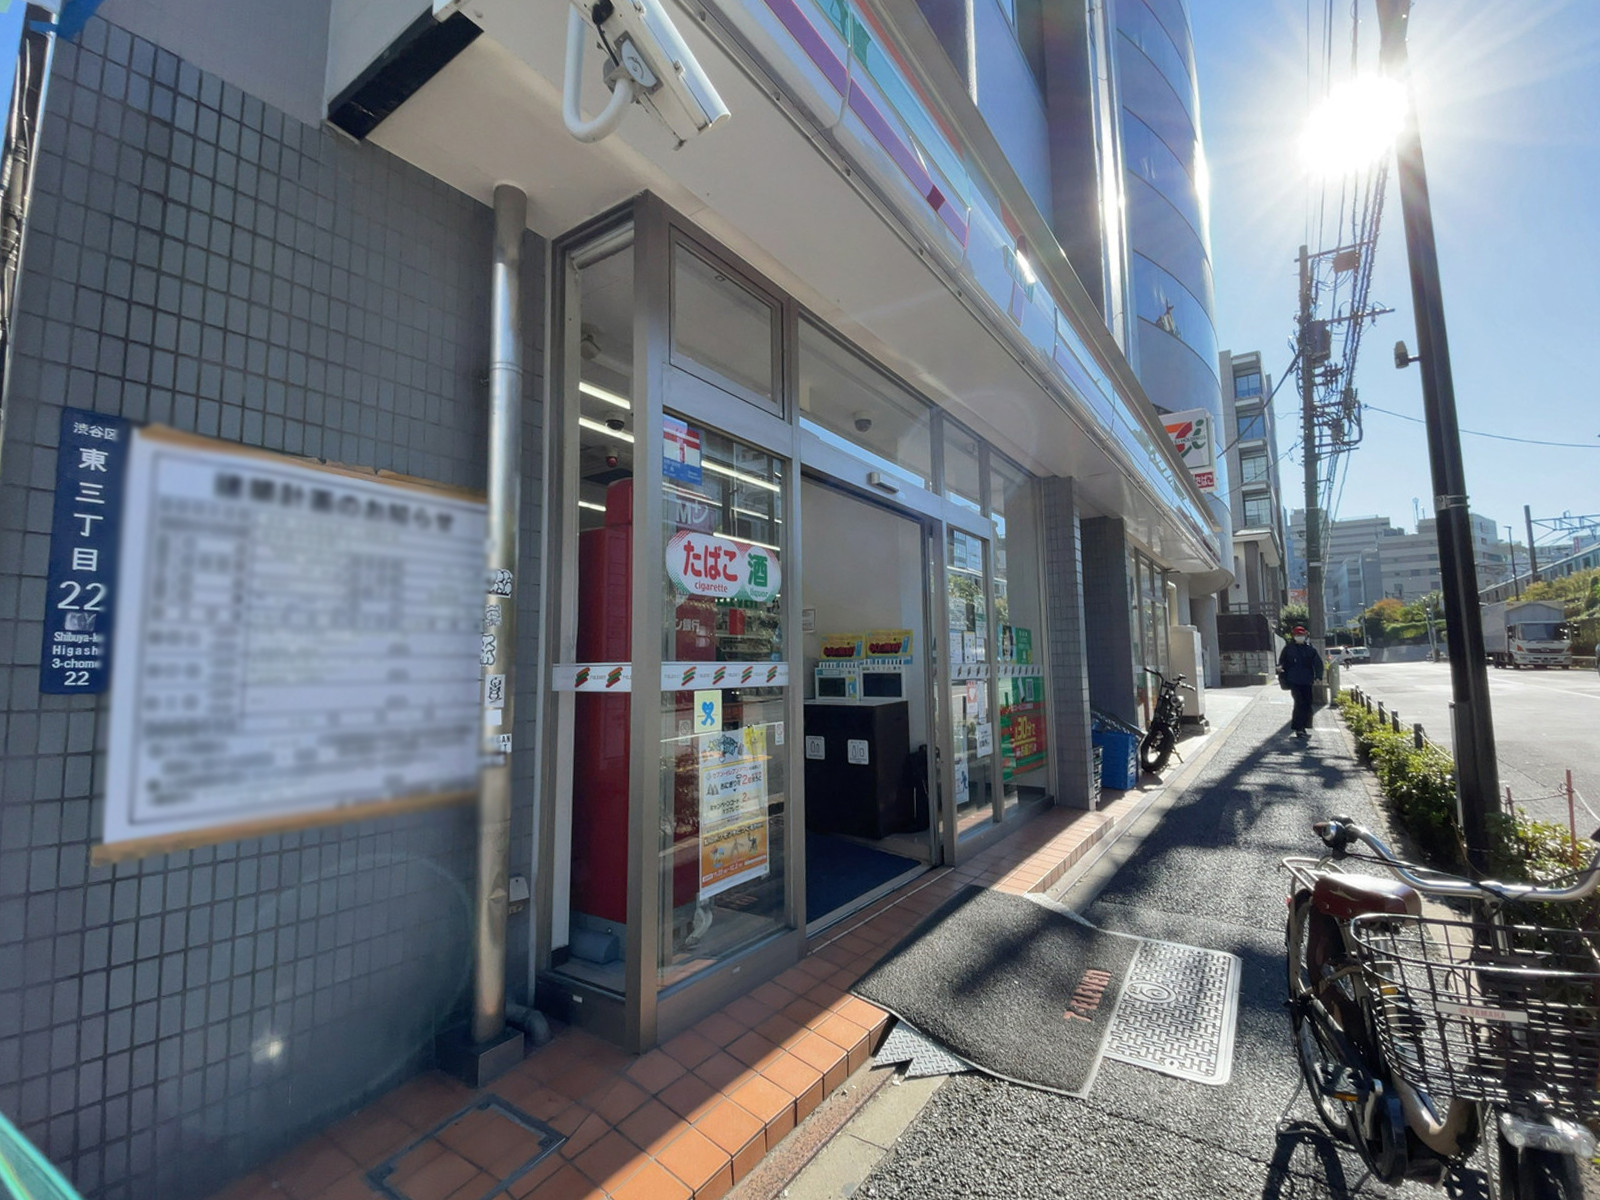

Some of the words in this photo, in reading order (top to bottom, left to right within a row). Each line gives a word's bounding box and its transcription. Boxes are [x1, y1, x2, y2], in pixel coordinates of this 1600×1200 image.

[73, 422, 118, 441] 渋谷区
[72, 448, 109, 572] 東三丁目
[683, 540, 739, 582] たばこ
[747, 552, 769, 587] 酒
[694, 582, 729, 593] cigarette
[57, 581, 107, 612] 22
[52, 645, 102, 656] Higash
[64, 671, 89, 686] 22
[1469, 1009, 1507, 1020] YAMAHA
